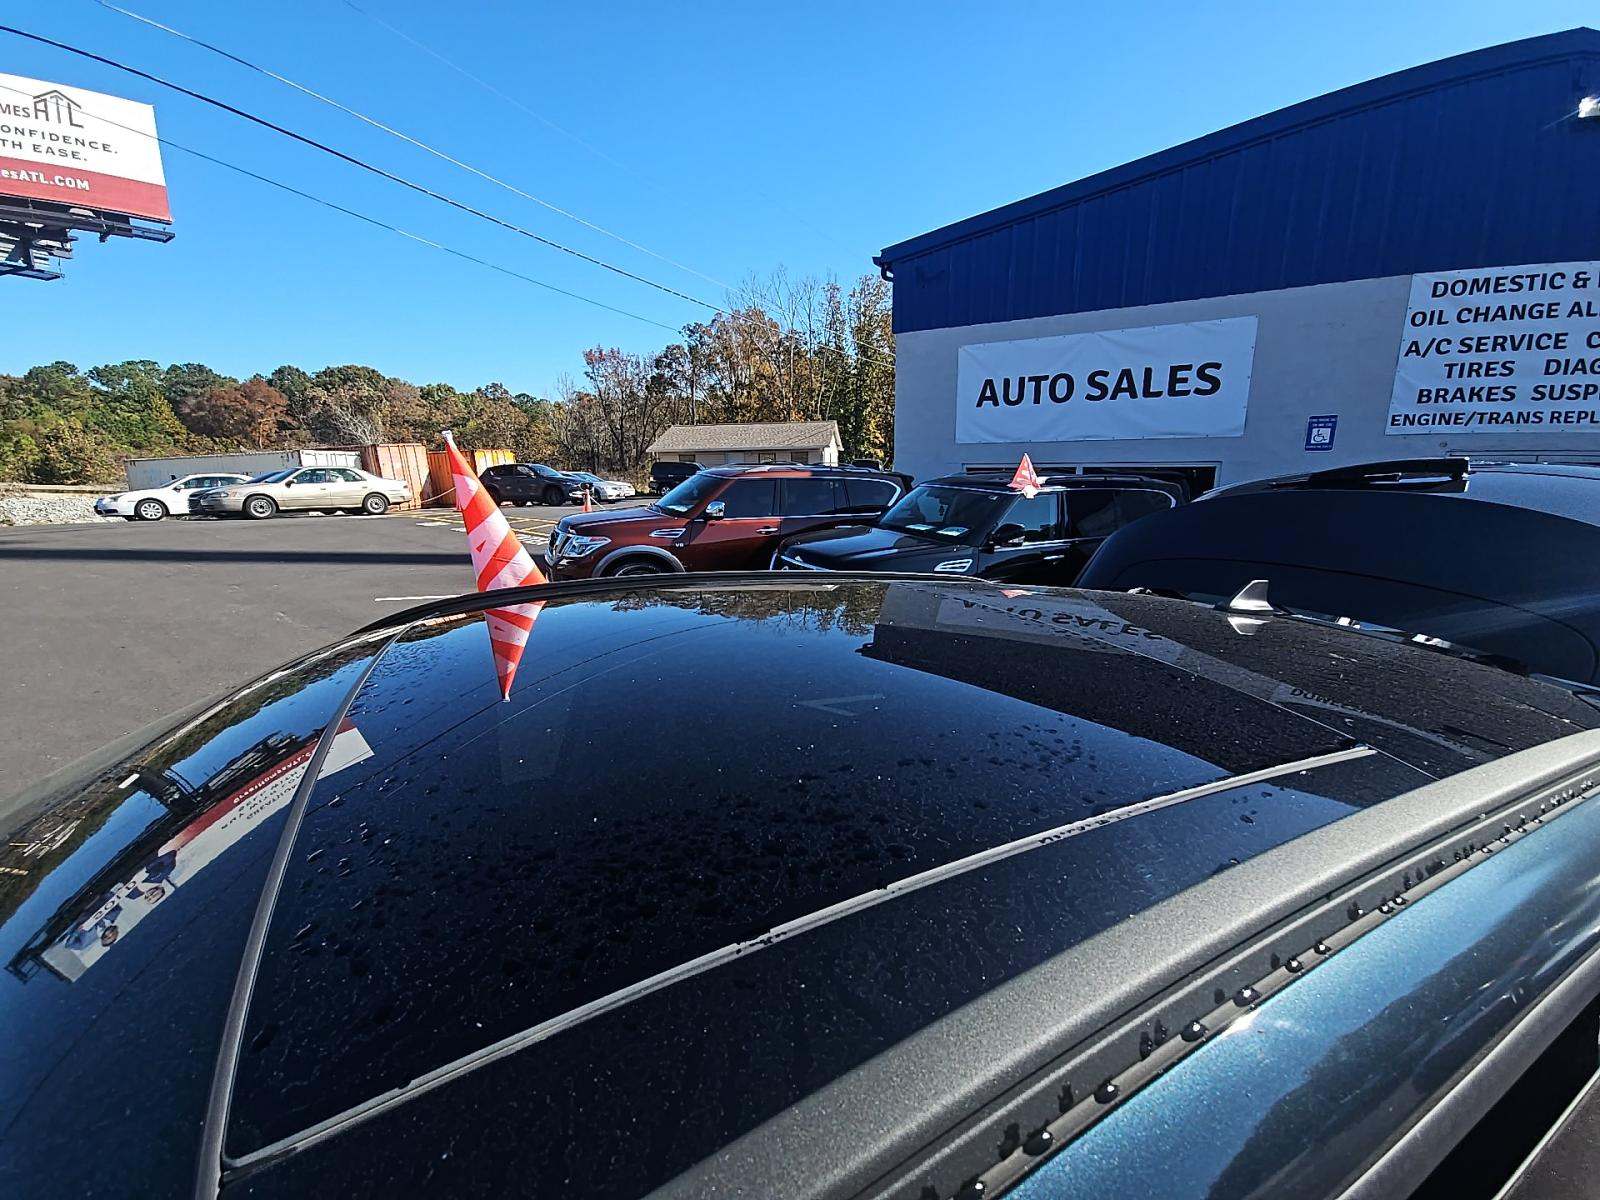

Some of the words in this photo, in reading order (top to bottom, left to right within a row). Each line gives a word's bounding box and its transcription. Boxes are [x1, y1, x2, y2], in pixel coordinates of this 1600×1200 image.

[32, 144, 88, 162] EASE.
[0, 169, 90, 191] esATL.COM
[1431, 272, 1566, 298] DOMESTIC
[1572, 271, 1591, 289] &
[1410, 310, 1449, 327] OIL
[1456, 302, 1560, 324] CHANGE
[1567, 301, 1600, 318] AL
[1403, 338, 1452, 358] A/C
[1457, 332, 1569, 354] SERVICE
[1444, 360, 1516, 379] TIRES
[975, 373, 1075, 408] AUTO
[1084, 361, 1223, 401] SALES
[1416, 386, 1517, 404] BRAKES
[1531, 384, 1600, 401] SUSP
[1390, 411, 1544, 427] ENGINE/TRANS
